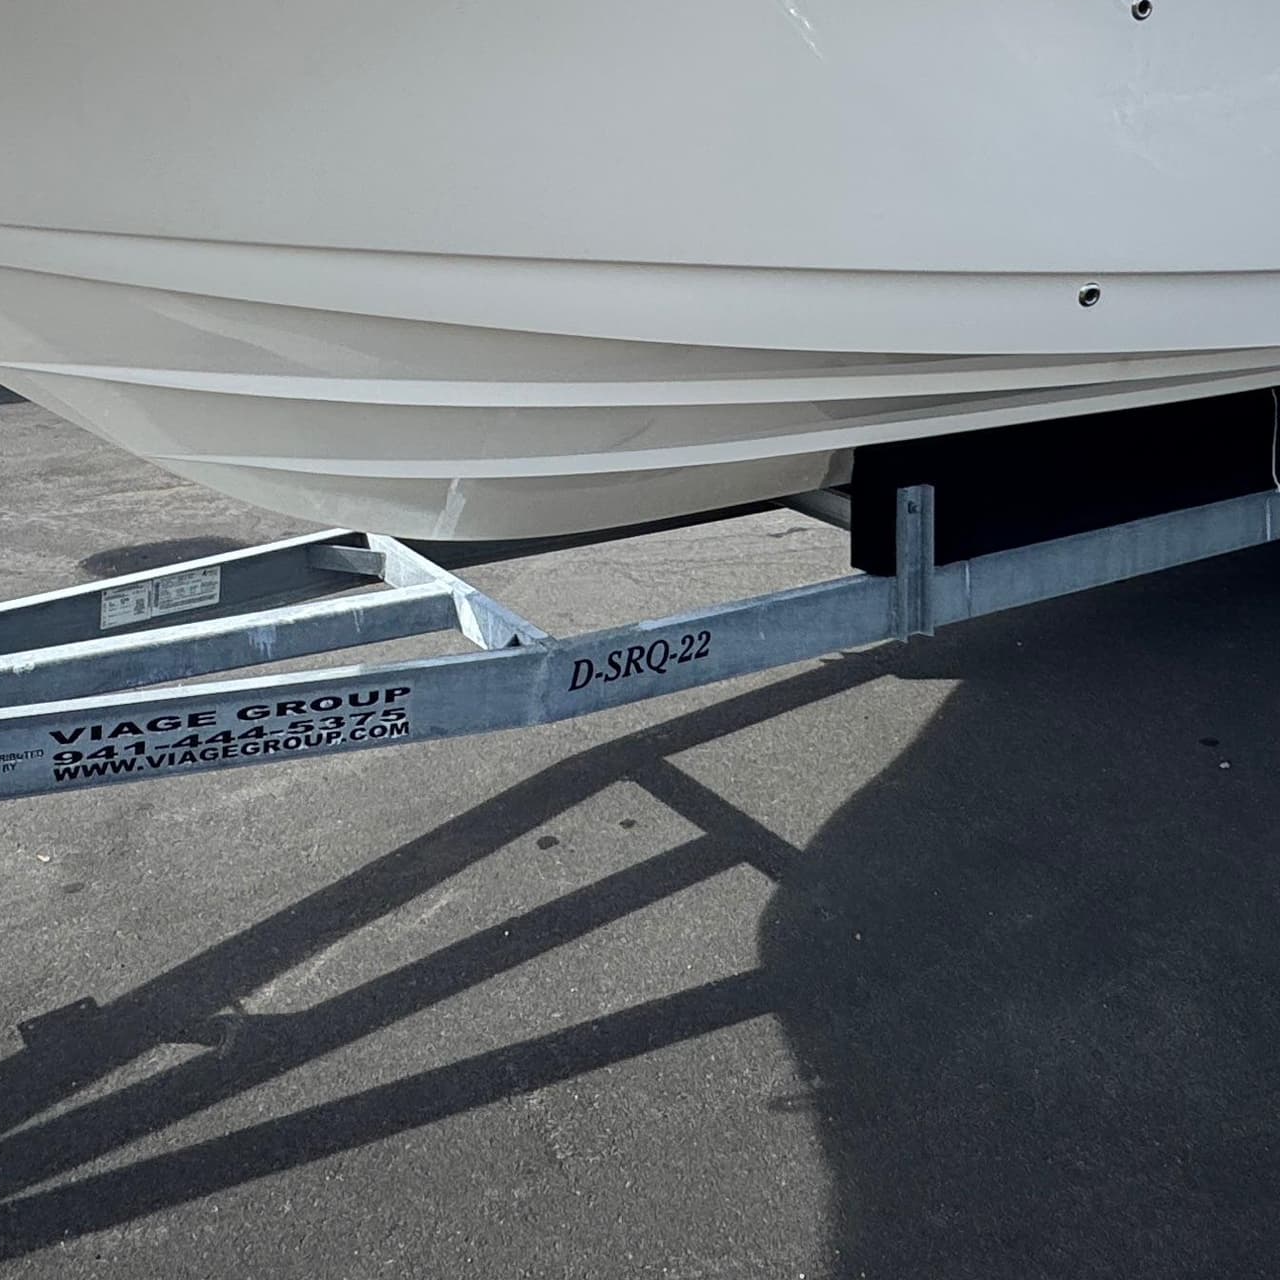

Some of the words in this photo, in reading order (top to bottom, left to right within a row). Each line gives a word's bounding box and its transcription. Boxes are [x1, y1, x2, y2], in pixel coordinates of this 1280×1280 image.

[568, 630, 711, 692] D-SRQ-22
[49, 710, 217, 745] VIAGE
[236, 687, 411, 721] GROUP
[52, 707, 406, 766] 941-444-5375
[54, 721, 410, 782] WWW.VIAGEGROUP.COM
